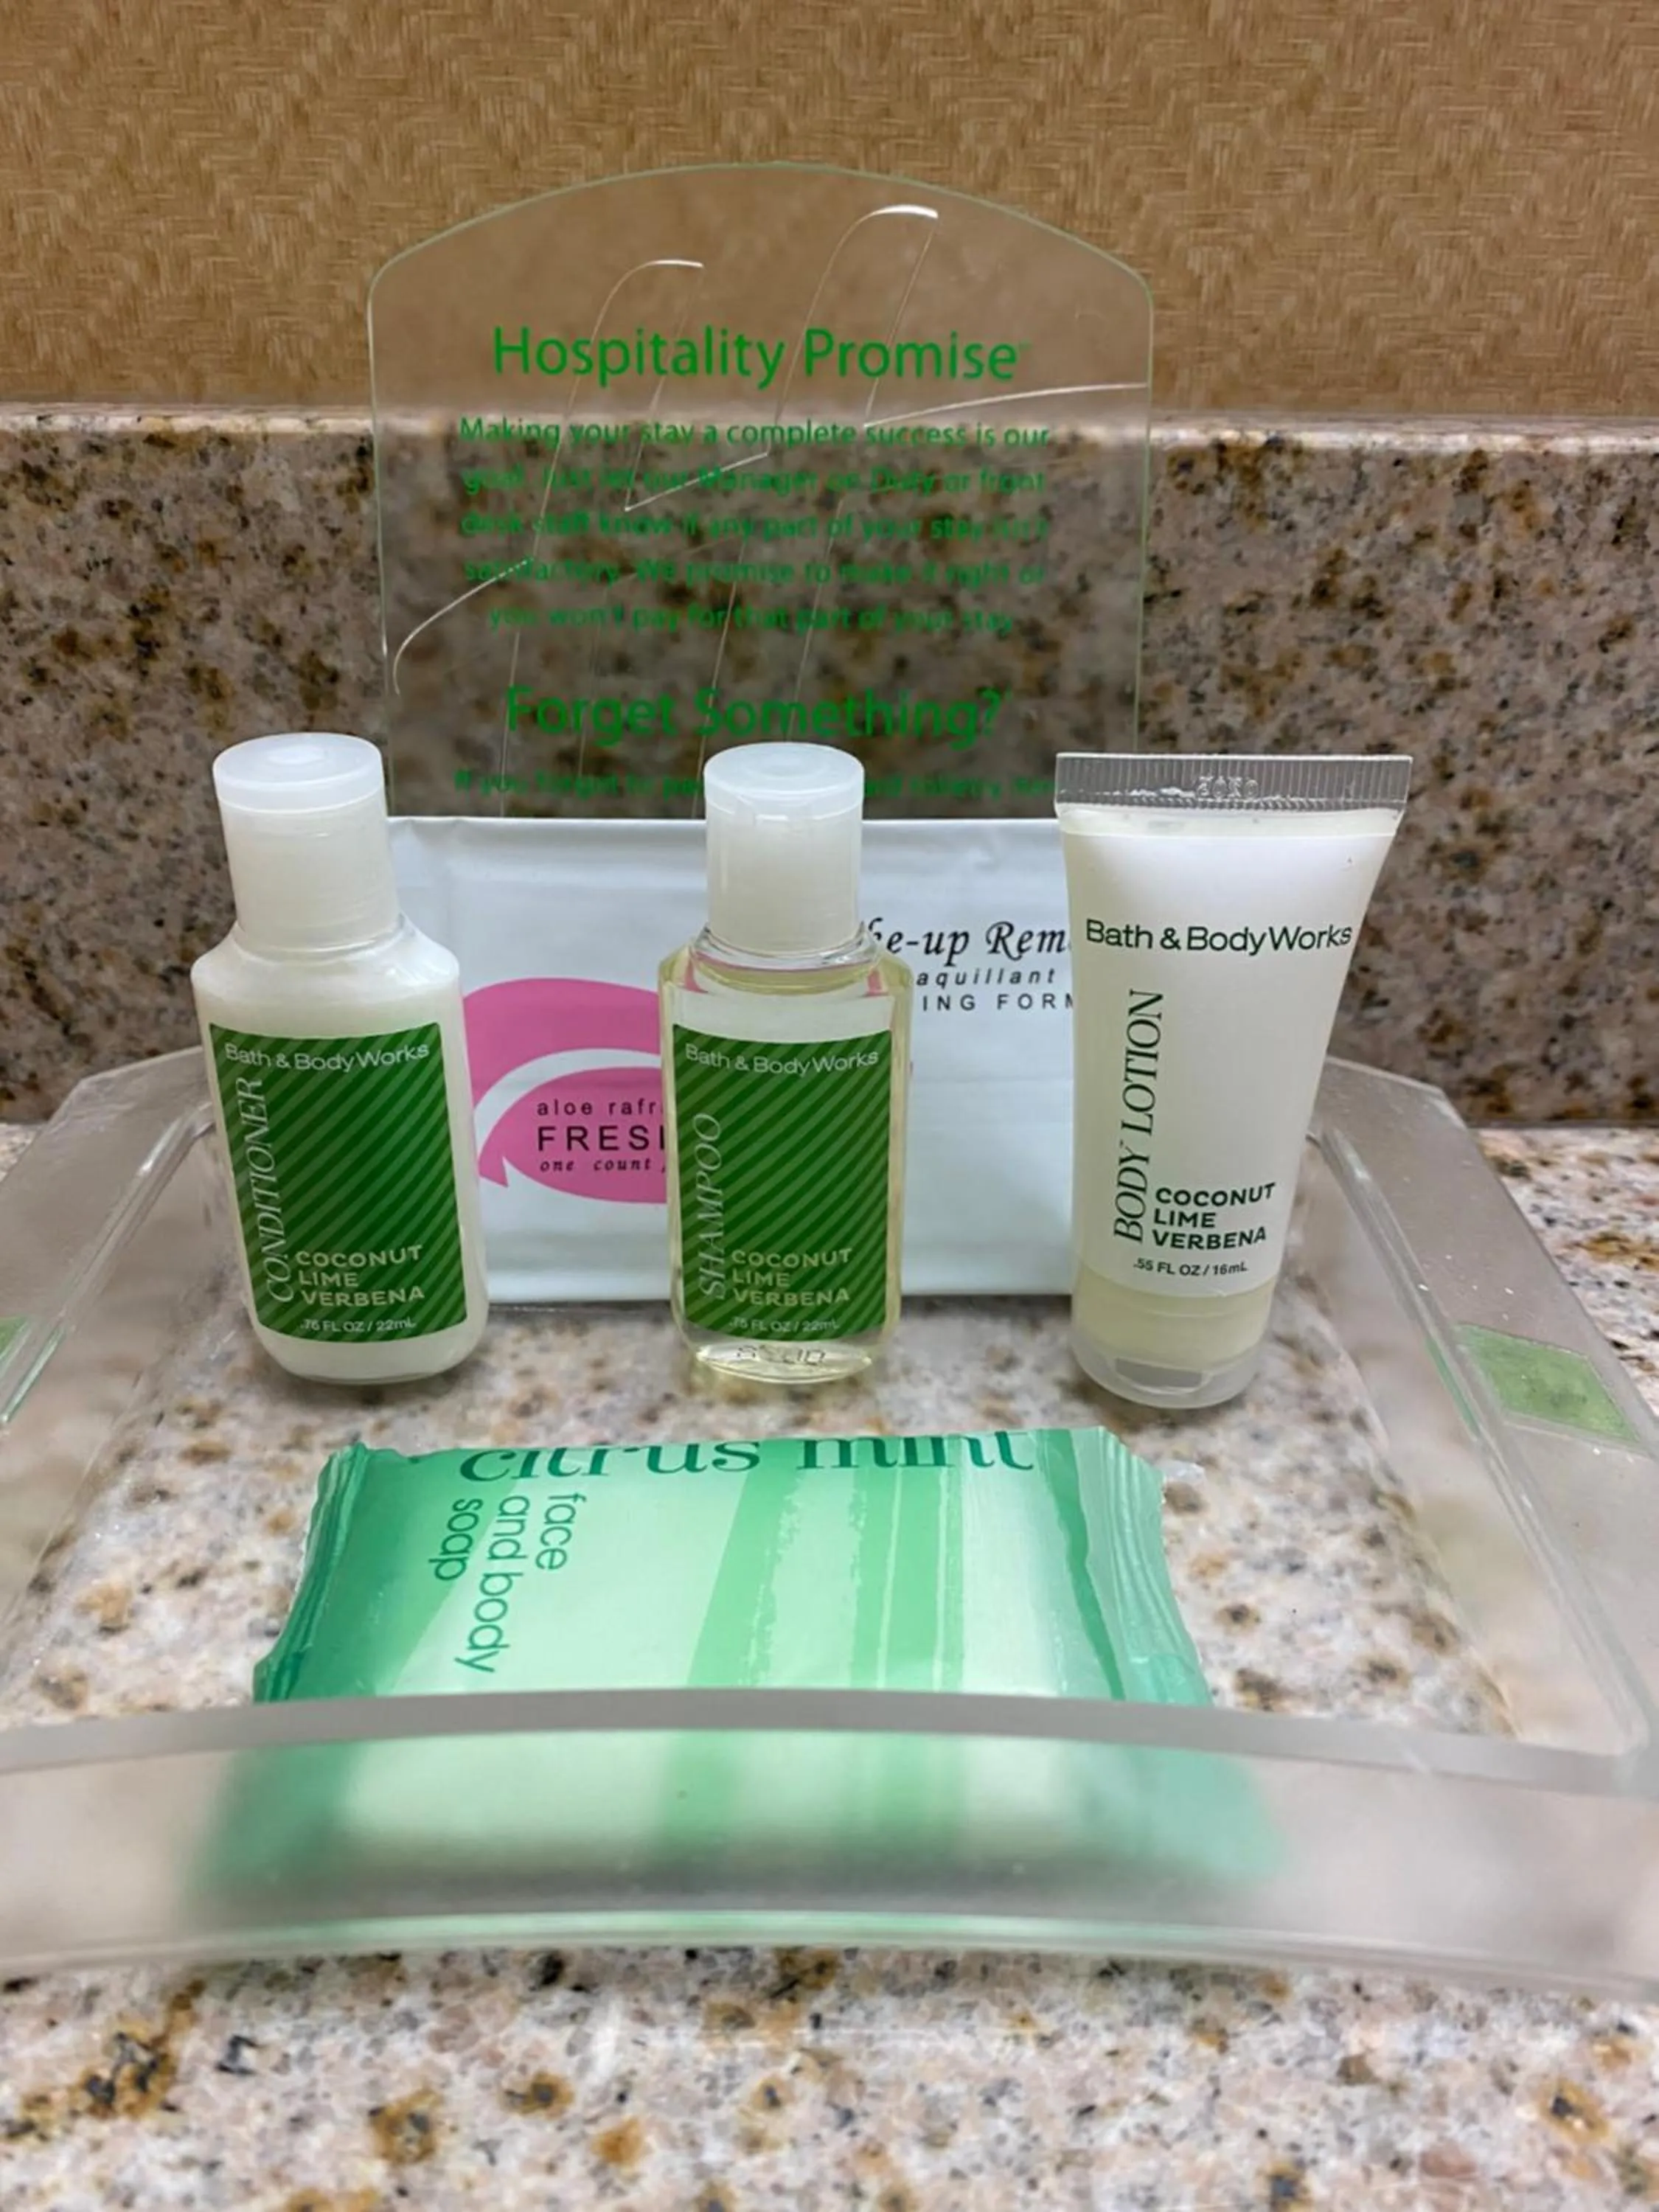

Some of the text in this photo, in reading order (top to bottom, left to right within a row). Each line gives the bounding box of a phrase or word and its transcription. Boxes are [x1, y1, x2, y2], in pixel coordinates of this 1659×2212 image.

[493, 325, 1018, 389] Hospitality Promise
[459, 416, 1051, 451] Making your stay a complete success is our
[506, 684, 1001, 751] Forget Something?
[1085, 918, 1153, 950] Bath
[1160, 927, 1182, 950] &
[916, 967, 1057, 989] aquillant
[922, 995, 977, 1011] ING
[225, 1043, 271, 1068] Bath
[276, 1053, 292, 1069] &
[685, 1043, 731, 1069] Bath
[734, 1054, 750, 1071] &
[537, 1098, 663, 1116] aloe rafr
[1114, 988, 1164, 1244] BODY LOTION
[540, 1158, 652, 1172] one count
[235, 1077, 294, 1304] CONDITIONER
[1155, 1182, 1276, 1208] COCONUT
[692, 1113, 726, 1301] SHAMPOO
[1153, 1208, 1217, 1228] LIME
[1151, 1225, 1267, 1250] VERBENA
[296, 1245, 424, 1268] COCONUT
[731, 1247, 854, 1268] COCONUT
[1156, 1261, 1176, 1275] FL
[298, 1270, 360, 1287] LIME
[731, 1268, 791, 1288] LIME
[301, 1285, 425, 1307] VERBENA
[734, 1288, 850, 1307] VERBENA
[322, 1321, 342, 1332] FL
[428, 1497, 484, 1582] soap
[535, 1491, 588, 1571] face
[453, 1495, 531, 1673] and body
